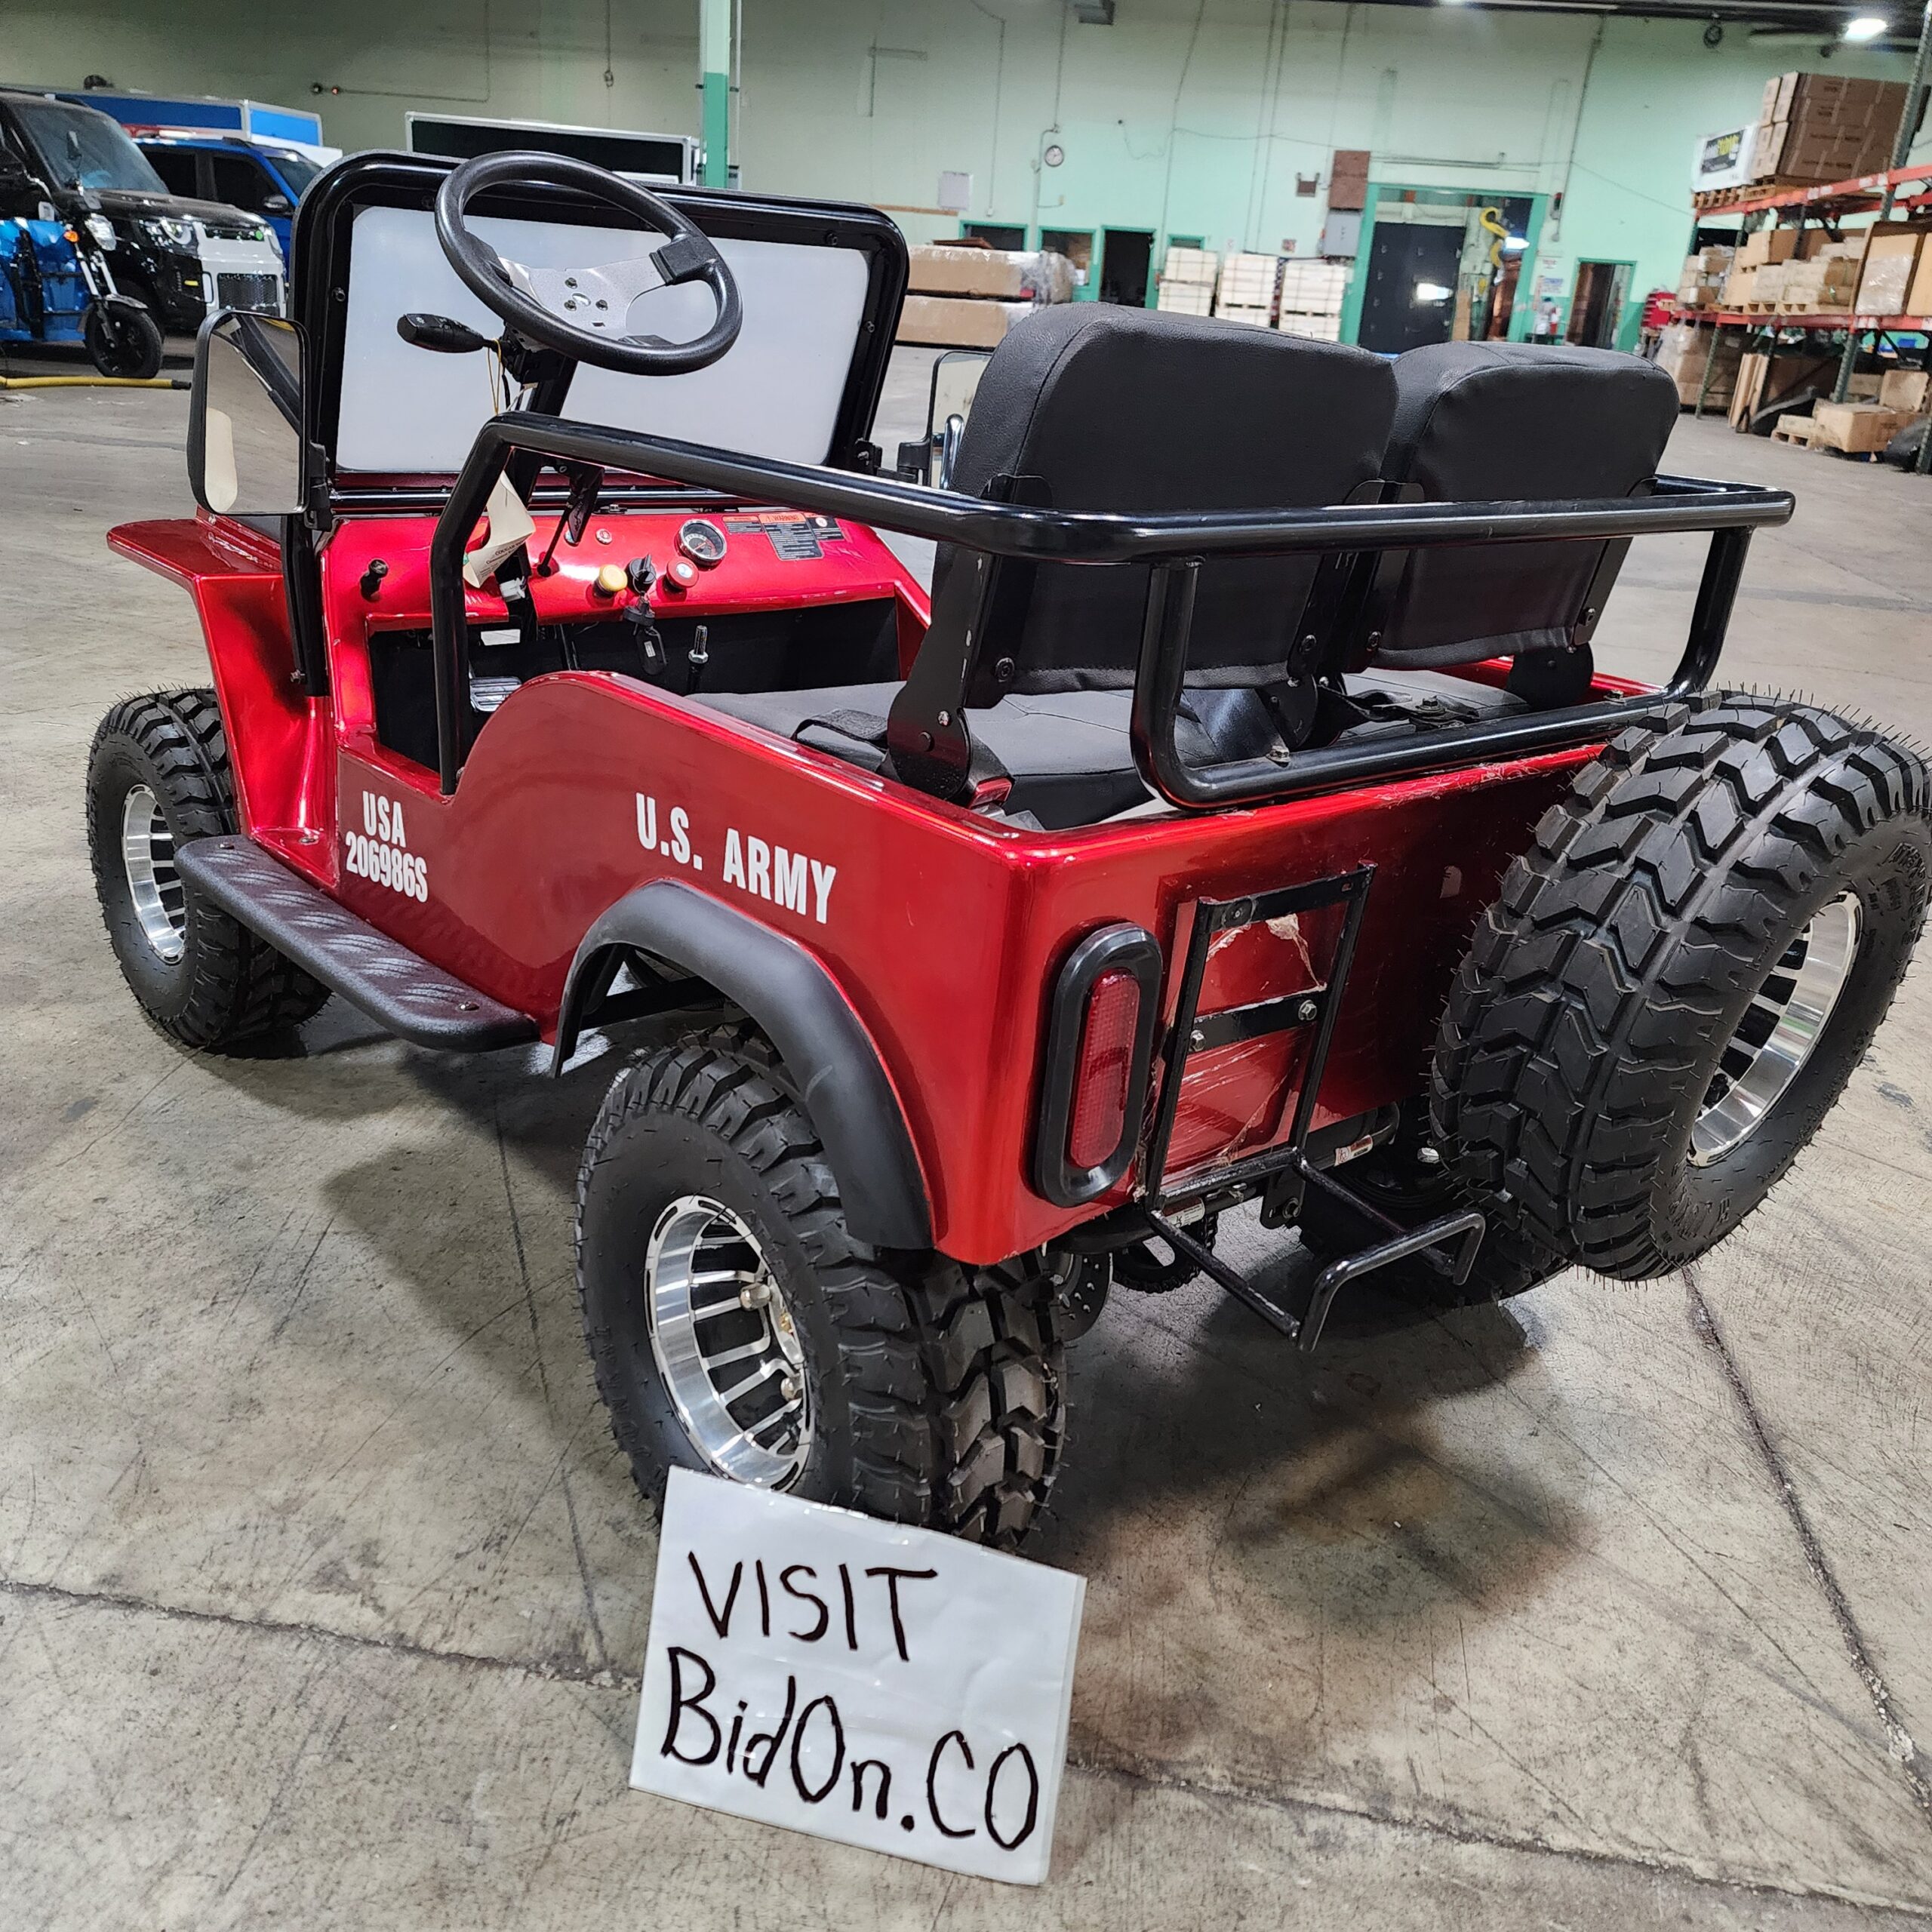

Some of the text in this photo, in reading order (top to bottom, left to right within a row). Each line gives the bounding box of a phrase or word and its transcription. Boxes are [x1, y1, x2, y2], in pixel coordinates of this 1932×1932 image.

[346, 831, 429, 903] 206986S
[362, 790, 406, 848] USA
[635, 792, 837, 924] U.S. ARMY
[688, 1551, 938, 1663] VISIT
[660, 1646, 1039, 1850] BidOn.CO
